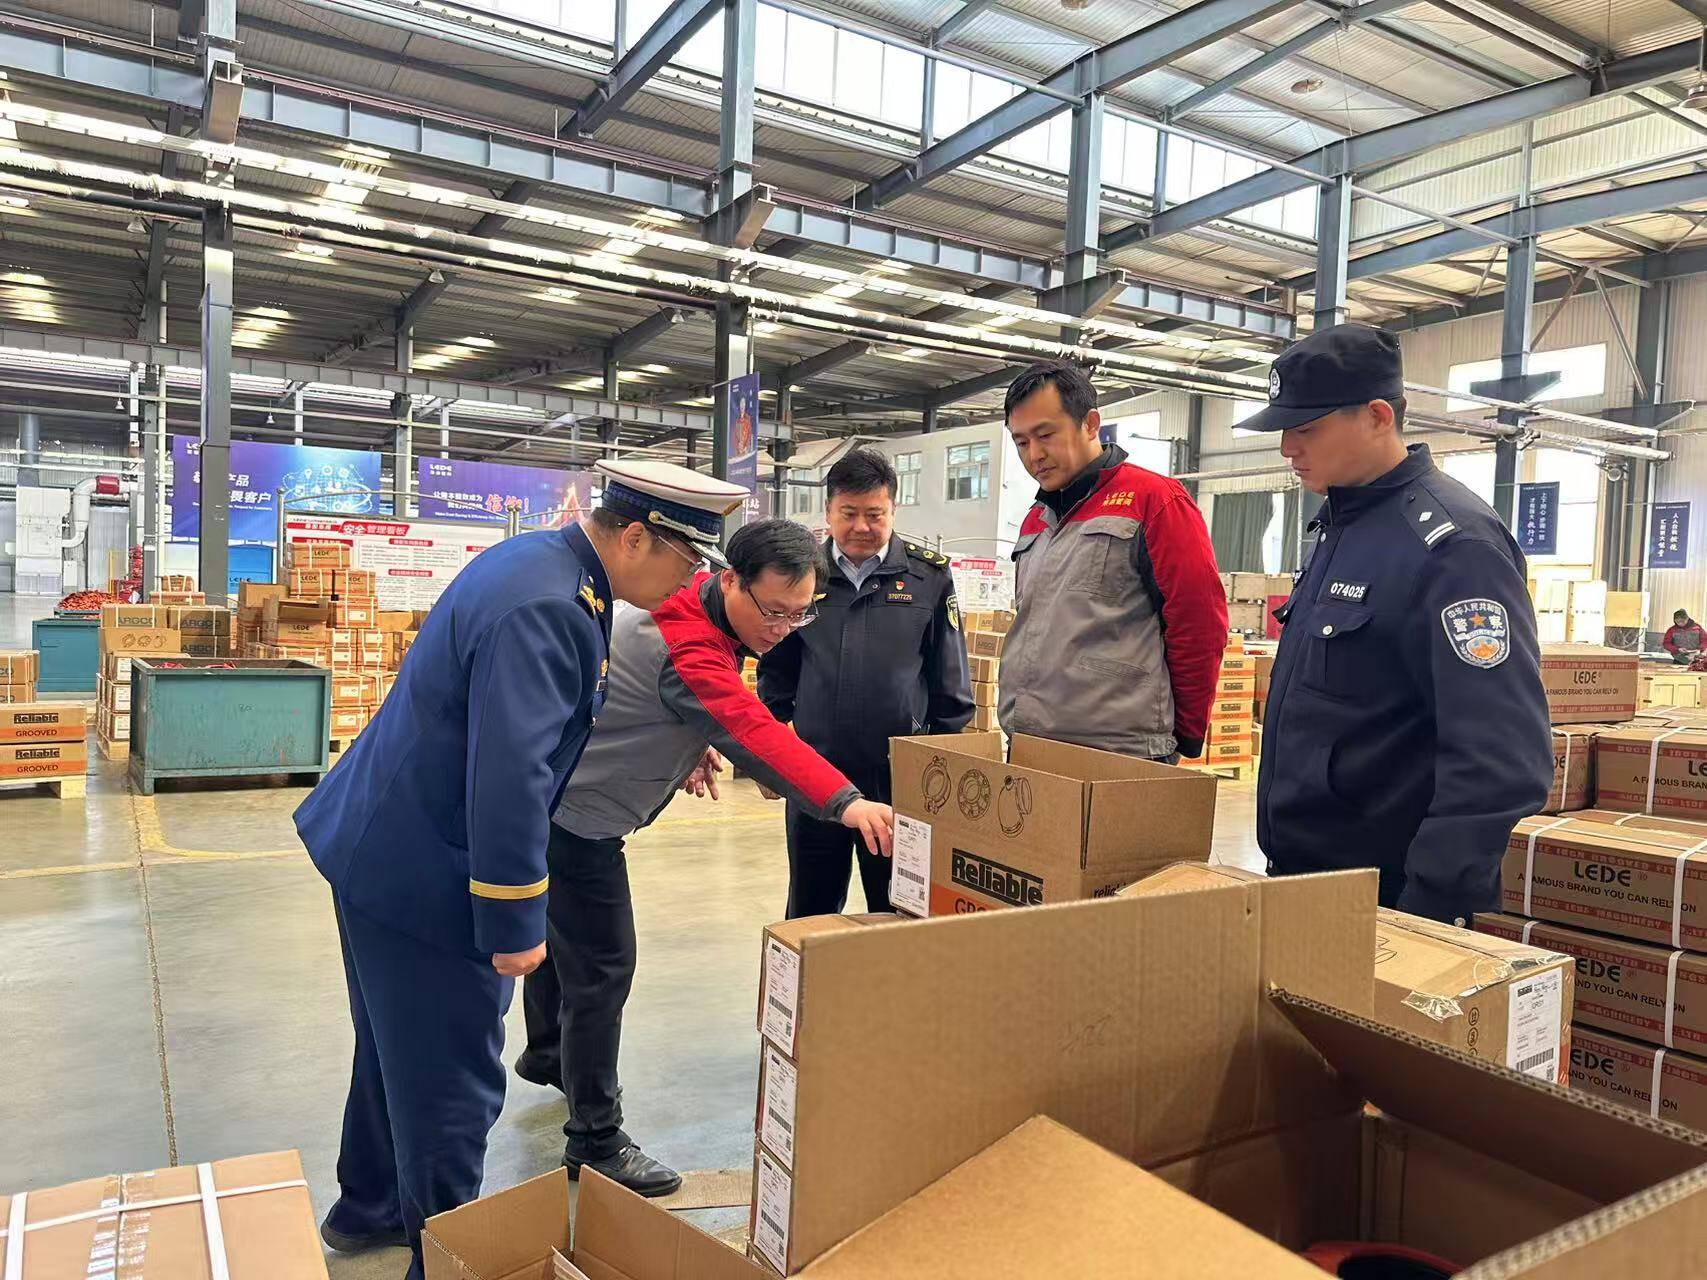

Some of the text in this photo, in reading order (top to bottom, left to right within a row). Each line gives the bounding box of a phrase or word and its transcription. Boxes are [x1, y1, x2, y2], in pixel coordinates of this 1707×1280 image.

[1330, 582, 1366, 599] 074025
[1573, 671, 1598, 684] LEDE
[14, 713, 59, 723] Reliable
[16, 729, 57, 737] GROOVED
[15, 748, 60, 759] Reliable
[17, 764, 59, 773] GROOVED
[1632, 775, 1640, 783] A
[951, 848, 1044, 908] Reliable
[1574, 861, 1632, 887] LEDE
[1517, 873, 1696, 913] A AMOUS BRAND YOU CAN REL ON
[1575, 957, 1621, 983] EDE
[1593, 983, 1614, 996] YOU
[1616, 989, 1638, 1001] CAN
[1570, 1048, 1615, 1076] EDE
[1588, 1074, 1608, 1088] YOU
[1610, 1082, 1631, 1095] CAN
[1634, 1089, 1652, 1103] REL
[1662, 1099, 1678, 1111] ON
